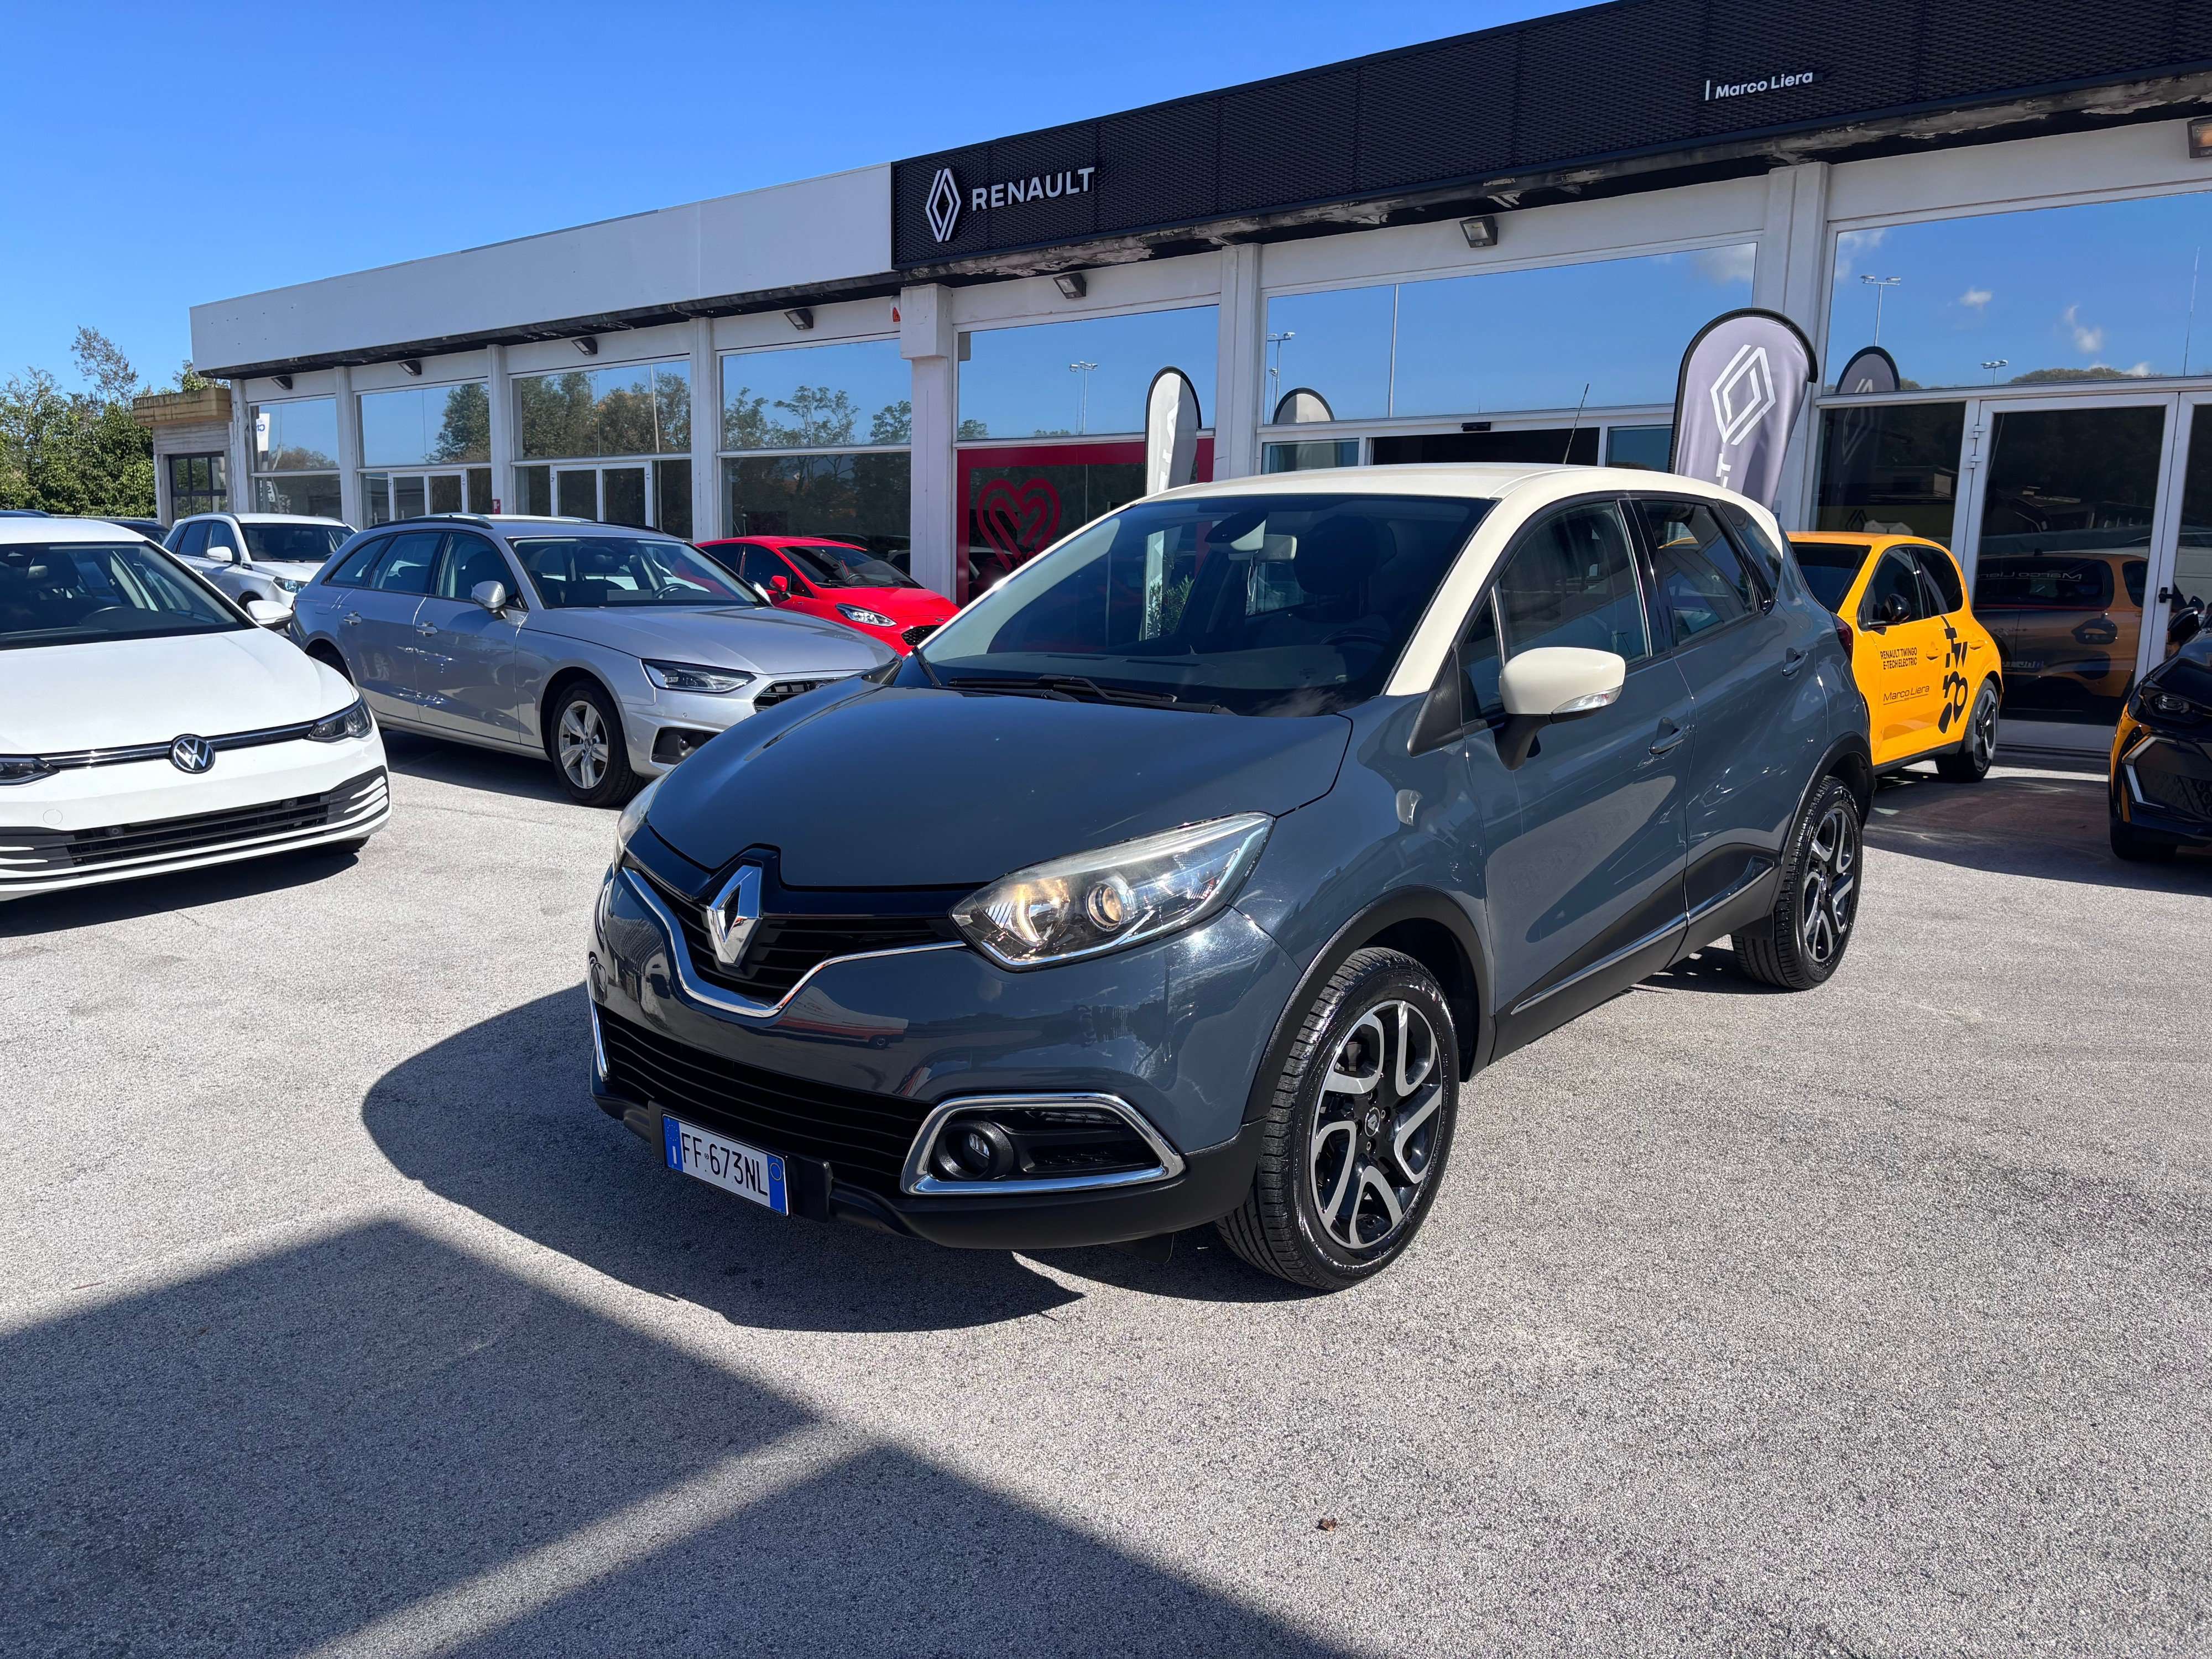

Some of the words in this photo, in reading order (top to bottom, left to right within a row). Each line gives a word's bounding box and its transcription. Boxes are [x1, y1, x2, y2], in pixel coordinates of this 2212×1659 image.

[1715, 81, 1768, 99] Marco
[1771, 72, 1813, 89] Liera
[972, 166, 1096, 211] RENAULT
[1880, 648, 1900, 659] RENAULT
[1901, 646, 1918, 657] TWINGO
[1883, 660, 1898, 670] E-TECH
[1898, 657, 1917, 668] ELECTRIC
[1883, 690, 1910, 702] Marco
[1911, 685, 1930, 696] Liera
